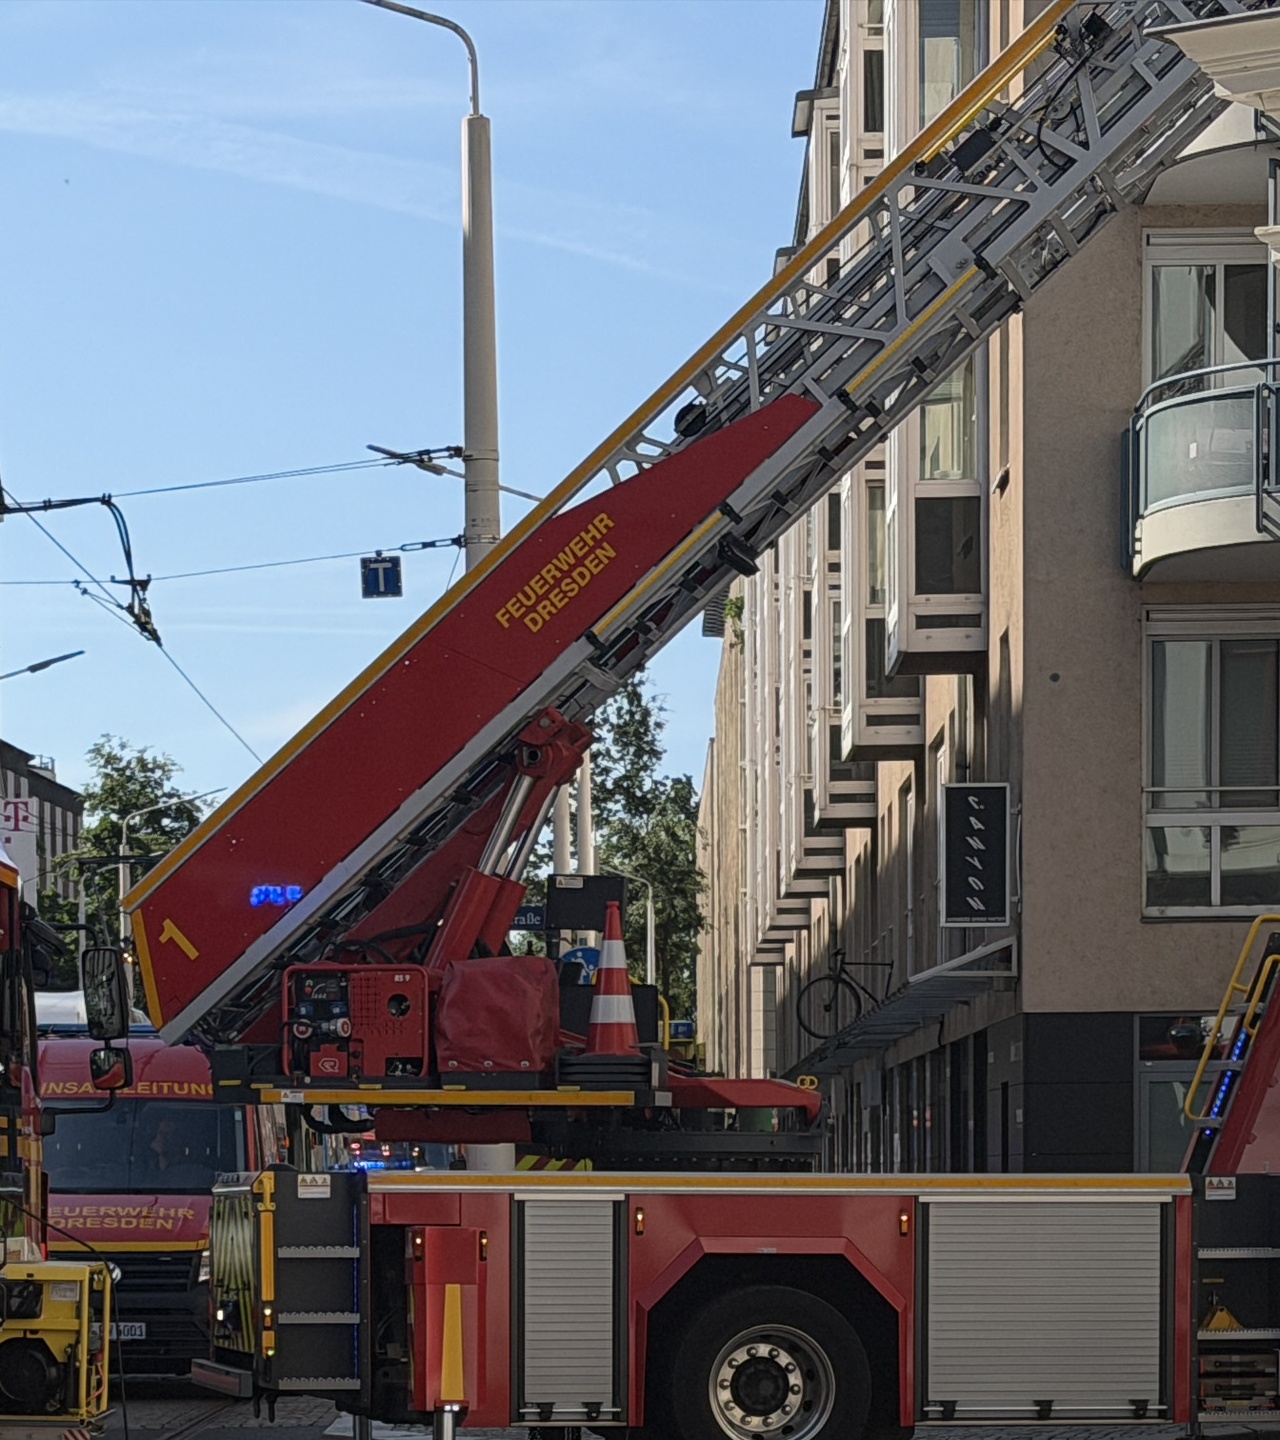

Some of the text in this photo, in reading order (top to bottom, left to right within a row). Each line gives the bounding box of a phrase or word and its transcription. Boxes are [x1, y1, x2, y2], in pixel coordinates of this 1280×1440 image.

[369, 562, 392, 592] T
[495, 512, 616, 629] FEUERWEHR
[523, 541, 618, 633] DRESDEN
[511, 912, 541, 925] raße
[159, 918, 200, 961] 1
[49, 1206, 195, 1219] EUERWEHR
